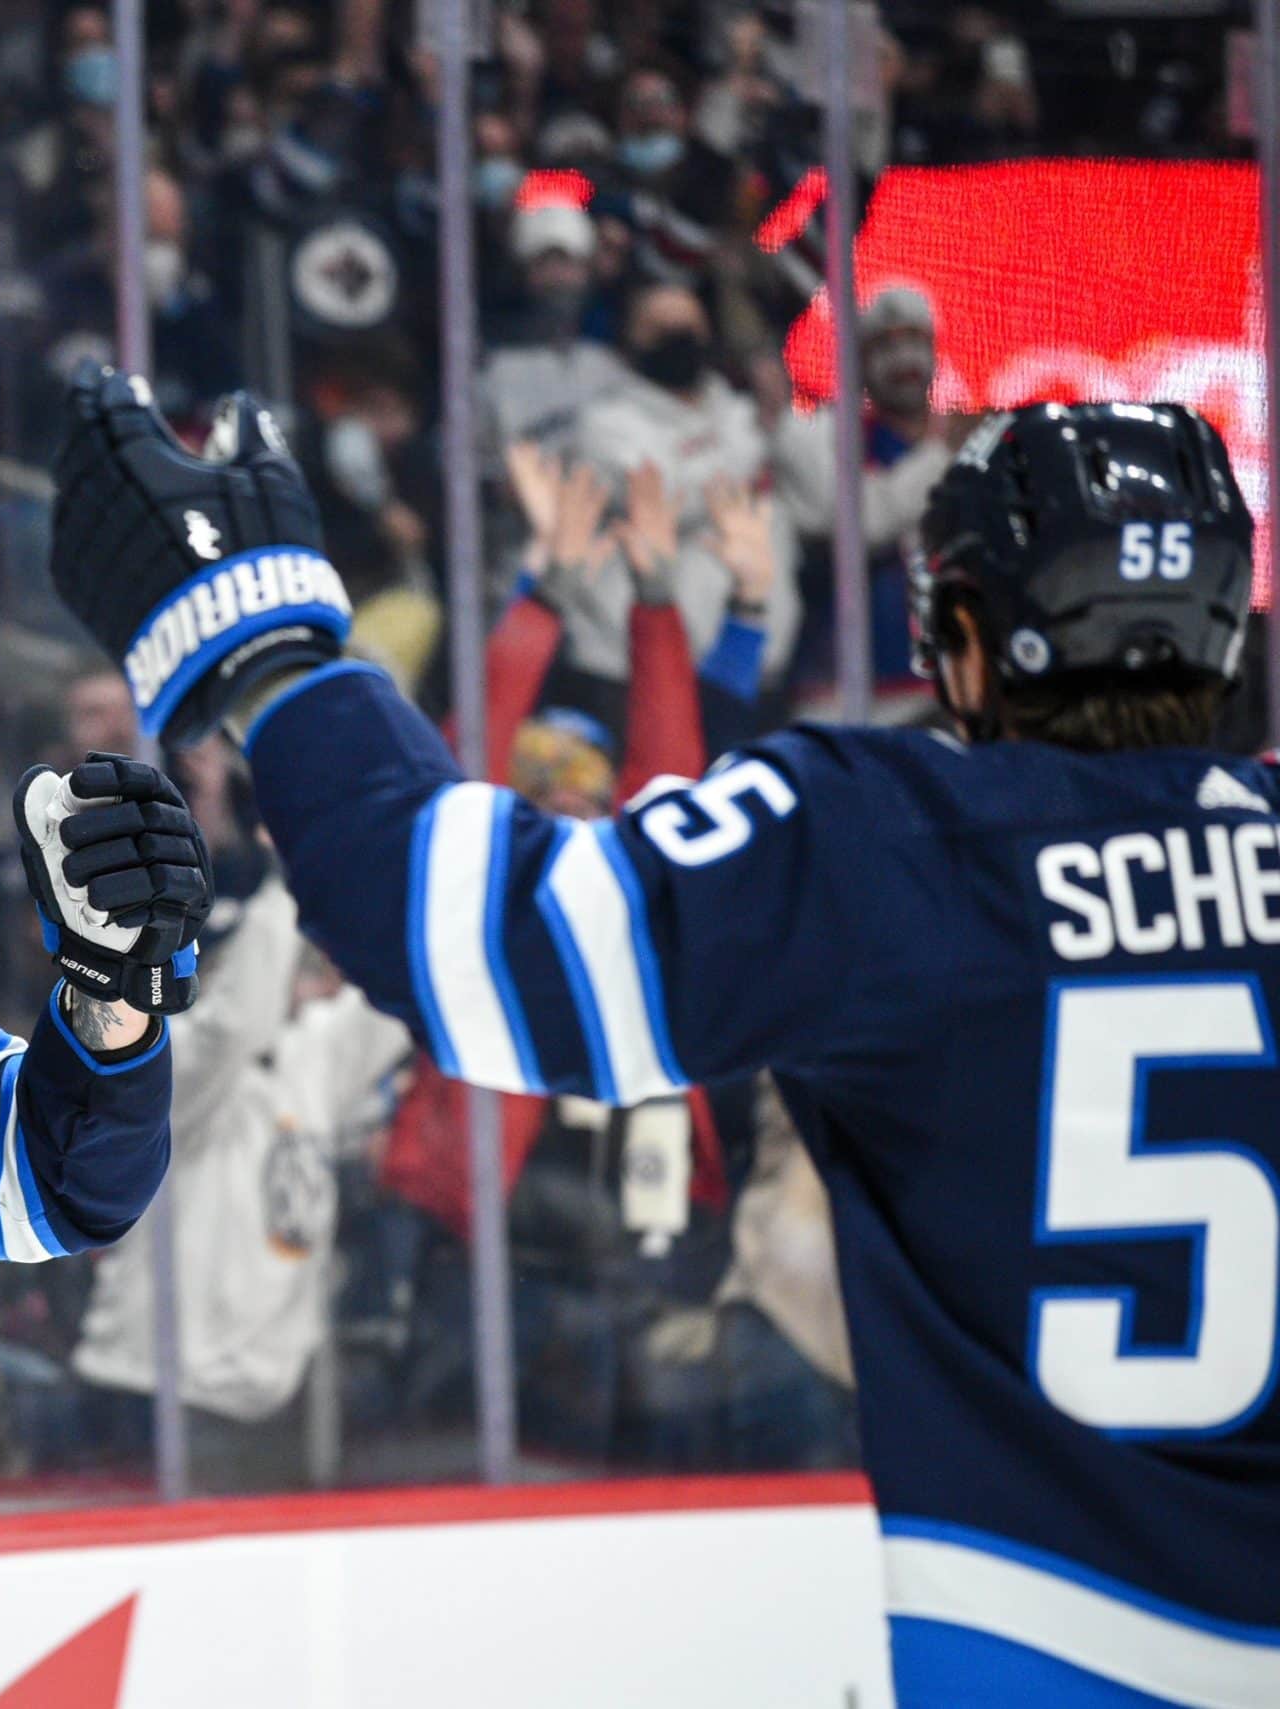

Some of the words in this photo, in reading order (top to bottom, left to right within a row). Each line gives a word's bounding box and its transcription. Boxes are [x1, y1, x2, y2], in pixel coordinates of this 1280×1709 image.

[1120, 521, 1193, 580] 55
[60, 955, 111, 985] BAUER
[151, 967, 162, 1006] DUBOIS
[1026, 970, 1280, 1442] 5
